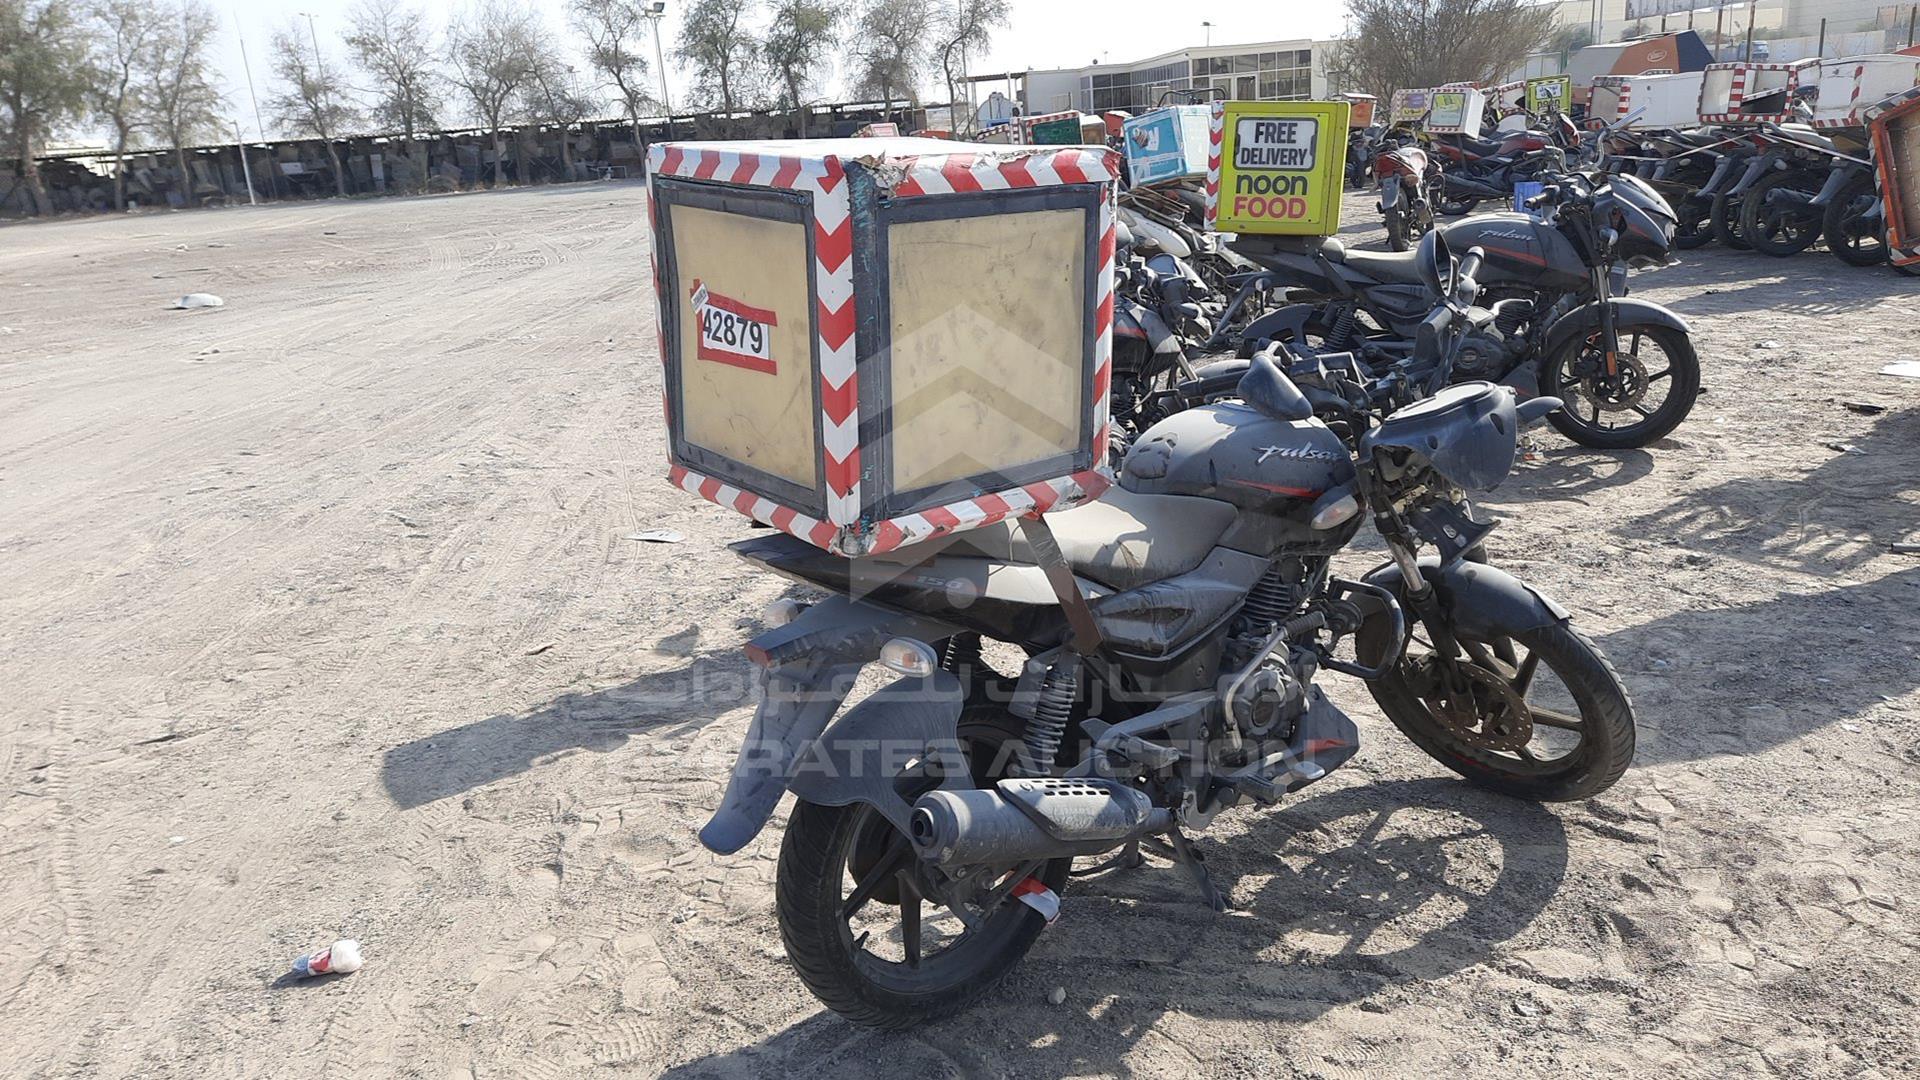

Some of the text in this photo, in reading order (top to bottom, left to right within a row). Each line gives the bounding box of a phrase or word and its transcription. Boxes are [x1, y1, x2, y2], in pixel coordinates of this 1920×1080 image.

[1254, 121, 1298, 144] FREE
[1240, 147, 1308, 166] DELIVERY
[1235, 174, 1308, 196] noon
[1234, 196, 1306, 219] FOOD
[702, 308, 763, 354] 42879
